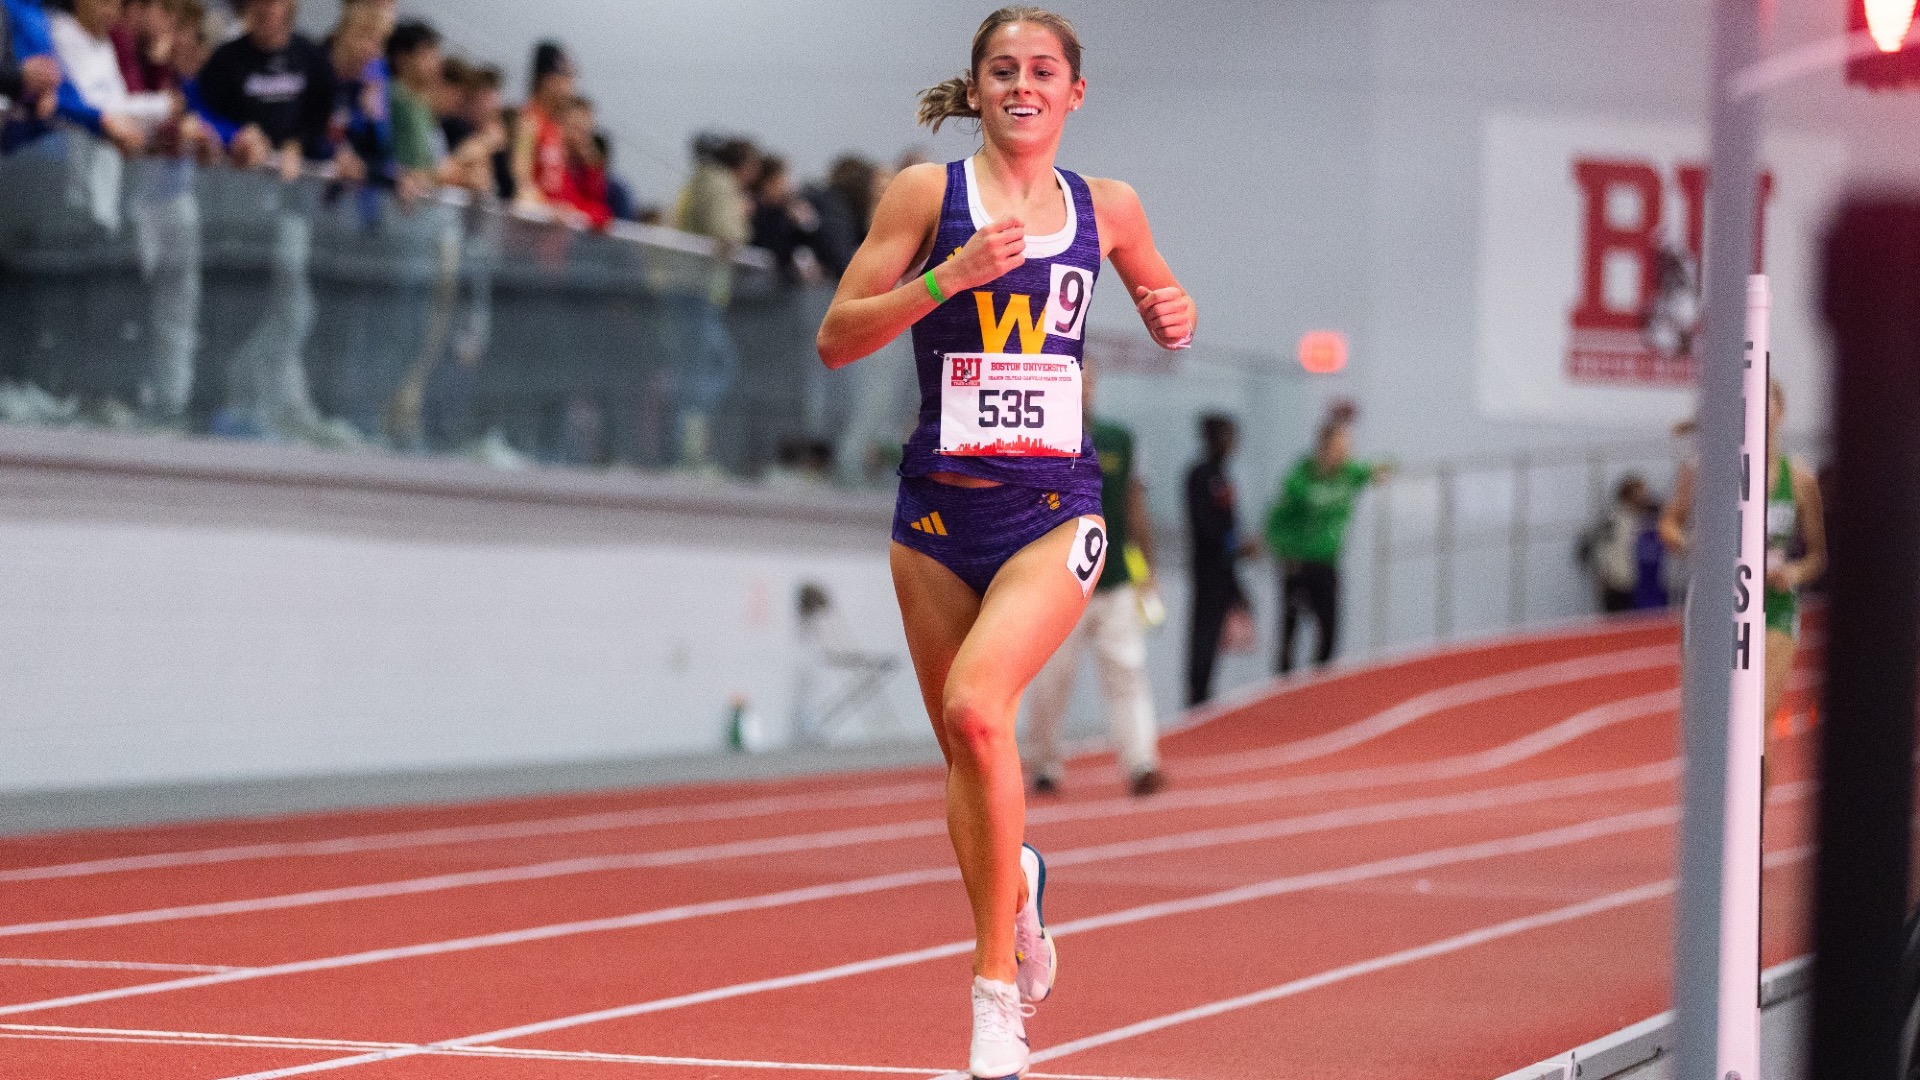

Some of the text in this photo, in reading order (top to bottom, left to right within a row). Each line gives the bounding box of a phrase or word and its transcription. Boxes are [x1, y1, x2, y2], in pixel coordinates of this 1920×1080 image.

[973, 291, 1047, 353] W
[1055, 270, 1084, 333] 9
[951, 358, 982, 380] BU
[991, 362, 1067, 372] BOSTON UNIVERSITY
[978, 390, 1045, 428] 535
[1075, 527, 1103, 581] 9
